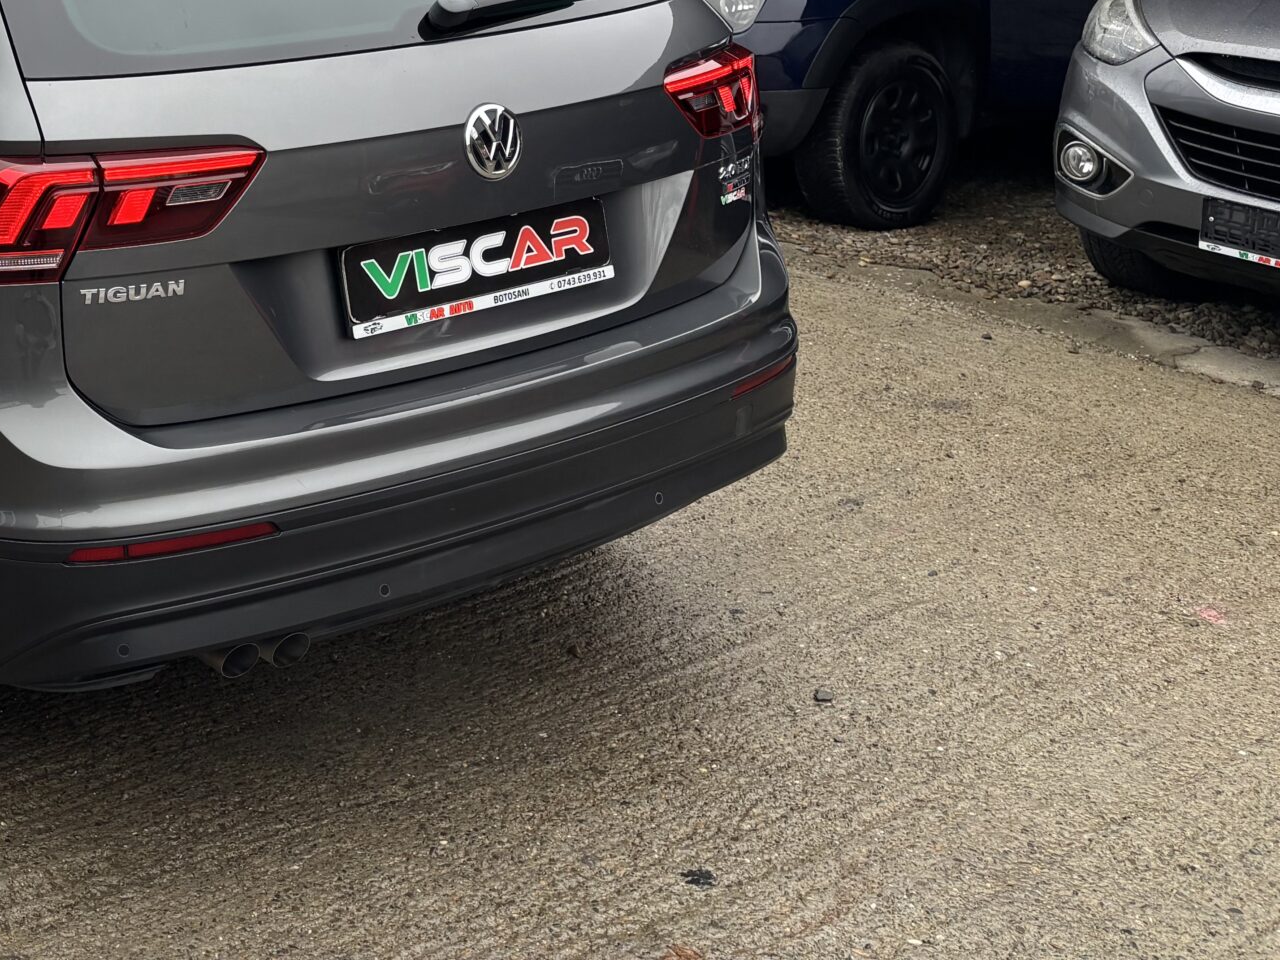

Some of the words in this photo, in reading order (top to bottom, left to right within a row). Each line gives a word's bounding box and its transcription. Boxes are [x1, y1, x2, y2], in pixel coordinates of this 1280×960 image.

[360, 215, 594, 300] VISCAR
[79, 279, 185, 305] TIGUAN
[405, 307, 445, 326] VISCAR
[449, 300, 474, 316] AUTO
[493, 288, 530, 304] BOTOSANI
[557, 270, 607, 289] 0743.639.931
